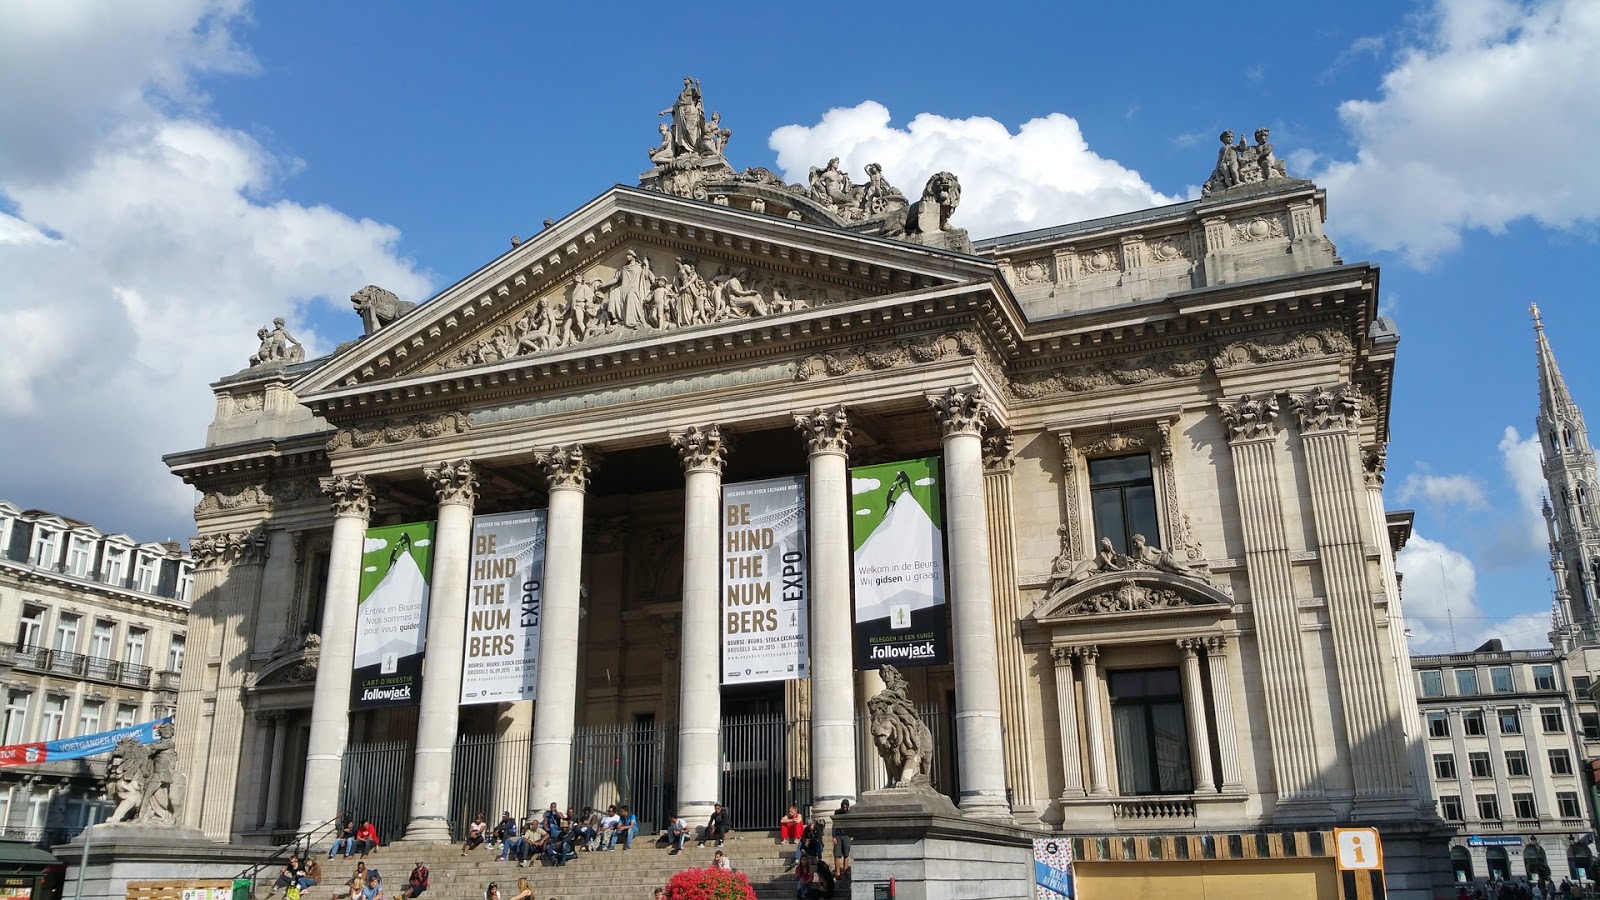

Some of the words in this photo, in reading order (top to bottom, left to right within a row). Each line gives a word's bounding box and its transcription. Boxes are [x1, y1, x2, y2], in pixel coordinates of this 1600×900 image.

[727, 503, 750, 526] BE
[476, 534, 497, 555] BE
[727, 528, 774, 552] HIND
[474, 558, 516, 580] HIND
[727, 555, 762, 579] THE
[783, 550, 803, 602] EXPO
[859, 565, 889, 574] Welkom
[902, 562, 911, 570] de
[860, 577, 873, 586] Wij
[876, 576, 902, 586] gidsen
[914, 572, 938, 582] graag
[473, 584, 505, 606] THE
[520, 580, 540, 628] EXPO
[728, 582, 770, 606] NUM
[364, 607, 386, 615] Entrez
[384, 614, 412, 622] sommes
[472, 608, 510, 631] NUM
[728, 608, 778, 634] BERS
[364, 627, 379, 636] pour
[400, 623, 420, 632] guider
[469, 634, 514, 657] BERS
[870, 642, 934, 659] .followjack
[381, 676, 413, 684] D'INVESTIR
[361, 686, 410, 700] .followjack
[60, 738, 110, 752] VOETGANGER
